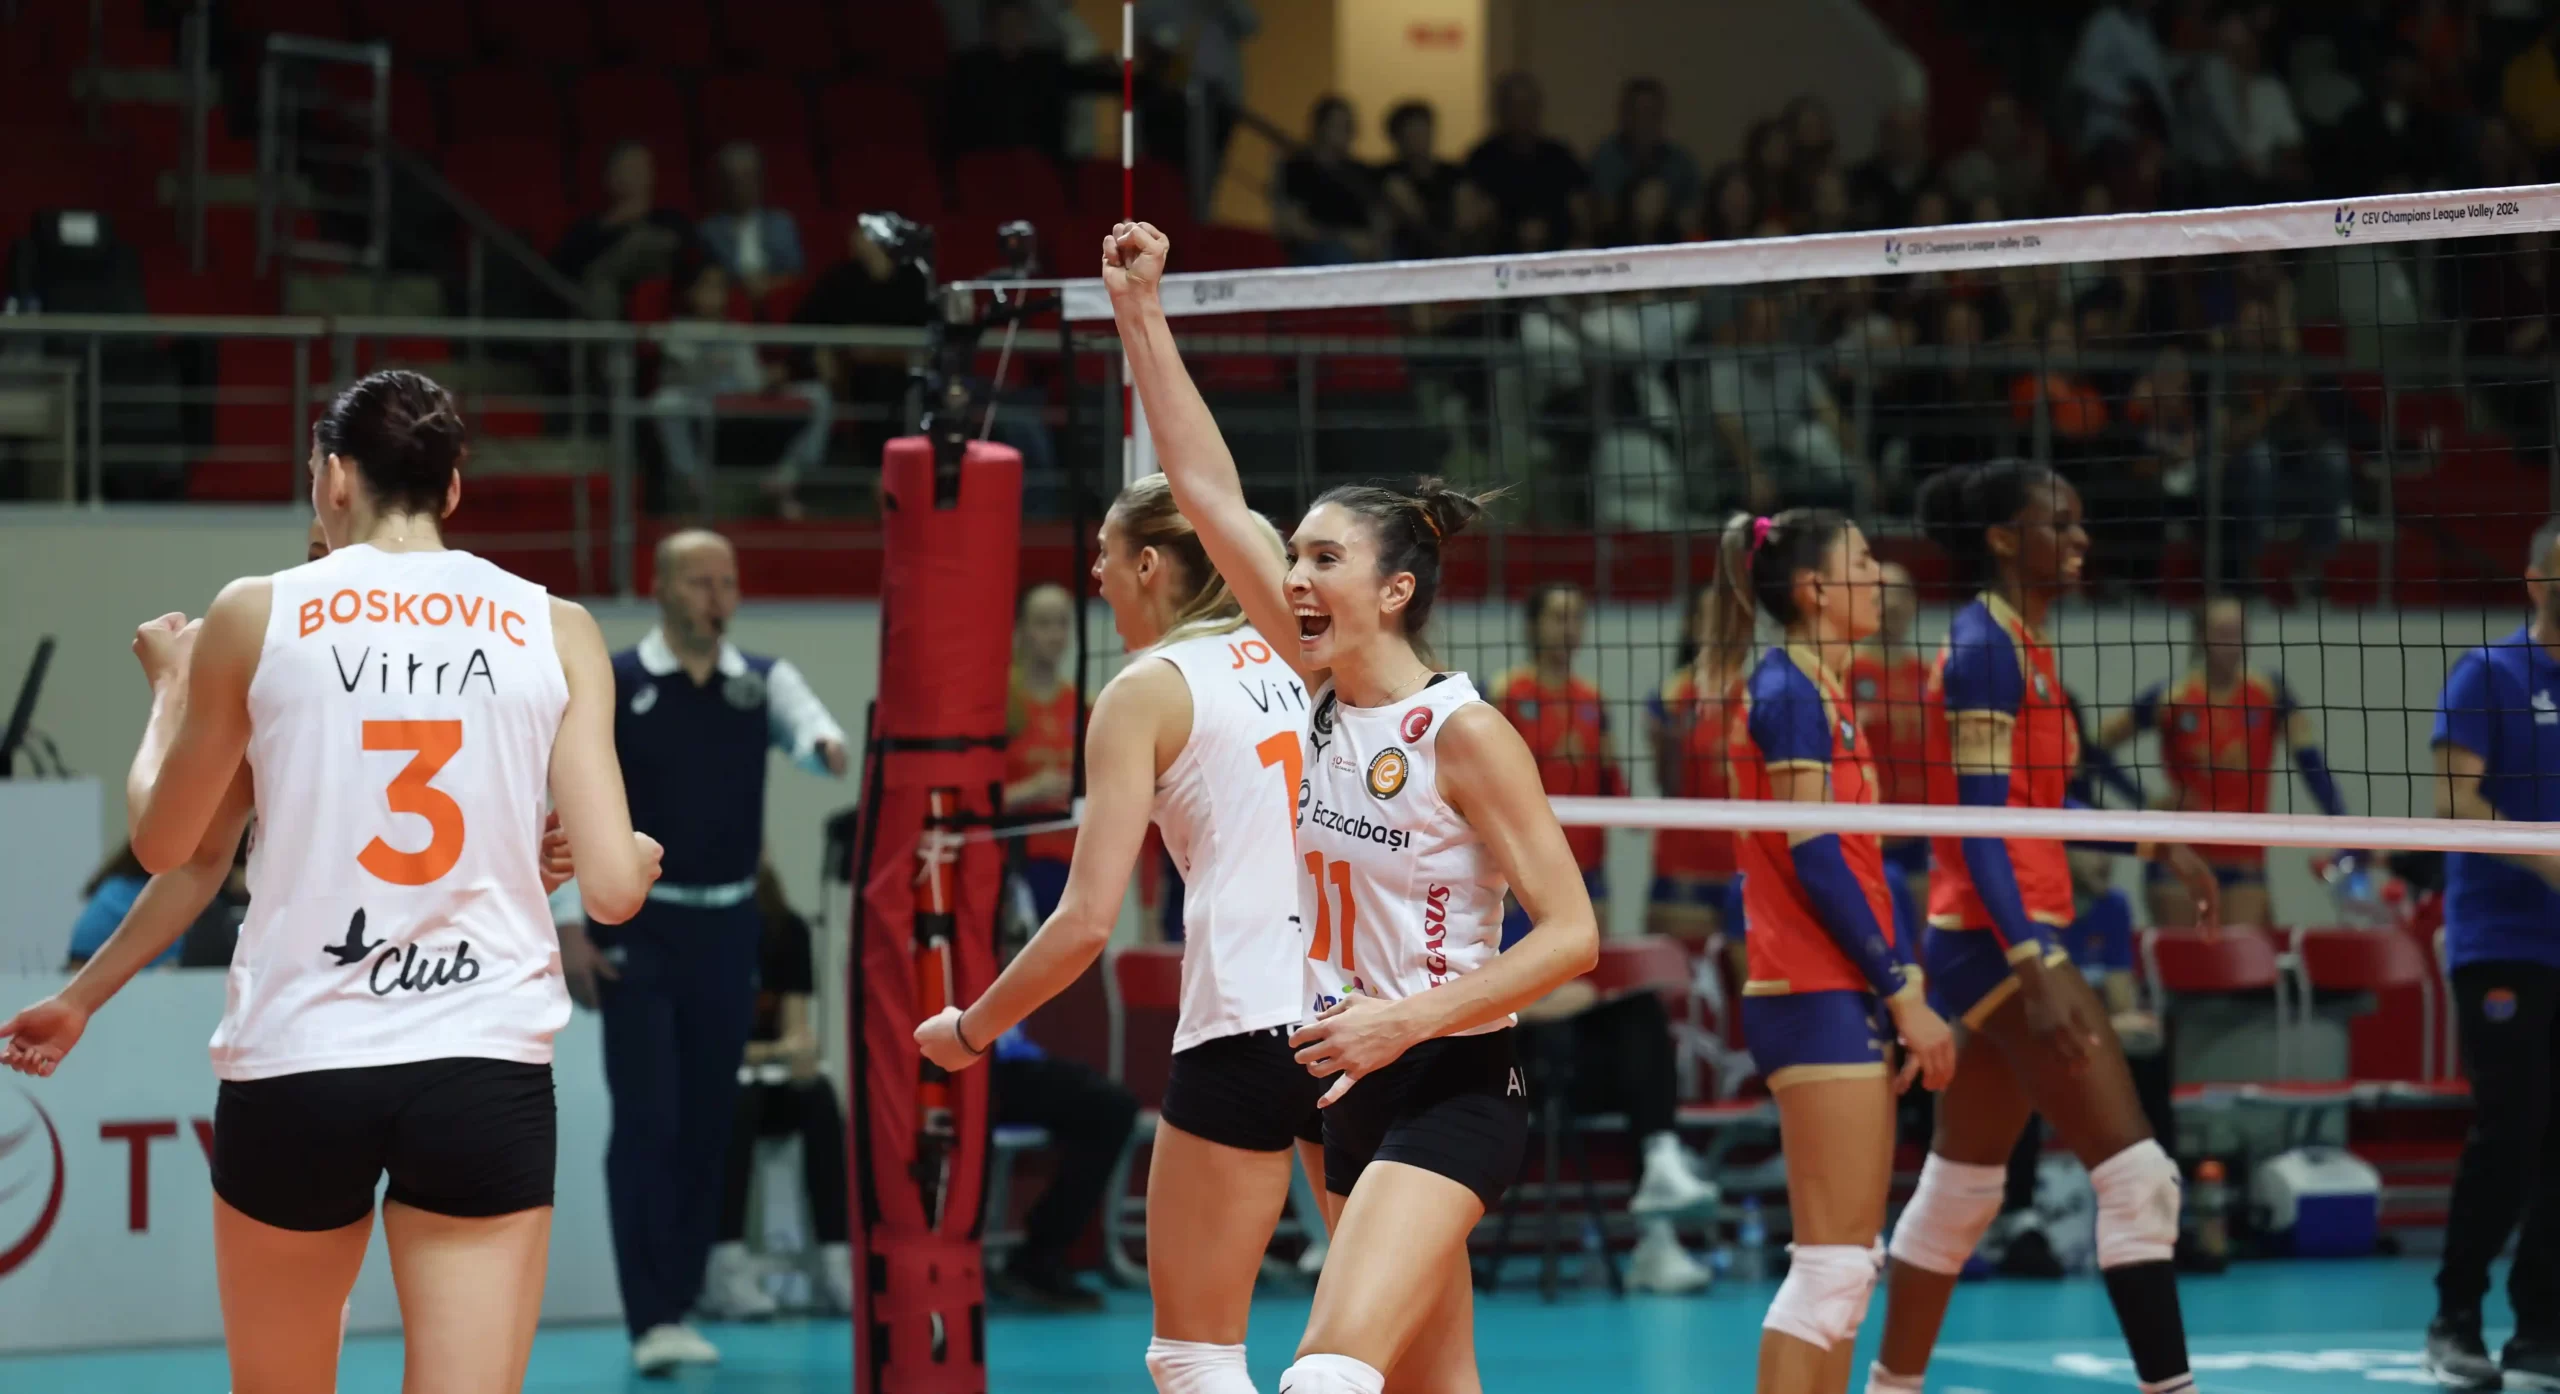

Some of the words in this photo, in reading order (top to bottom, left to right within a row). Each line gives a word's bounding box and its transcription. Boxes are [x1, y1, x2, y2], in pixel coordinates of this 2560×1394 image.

[2362, 212, 2380, 225] CEV
[2382, 209, 2431, 225] Champions
[2433, 207, 2466, 221] League
[2468, 204, 2494, 219] Volley
[2497, 202, 2520, 216] 2024
[299, 588, 526, 647] BOSKOVIC
[331, 644, 497, 696] VitrA
[356, 719, 467, 886] 3
[1304, 850, 1356, 972] 11
[370, 940, 480, 996] Club
